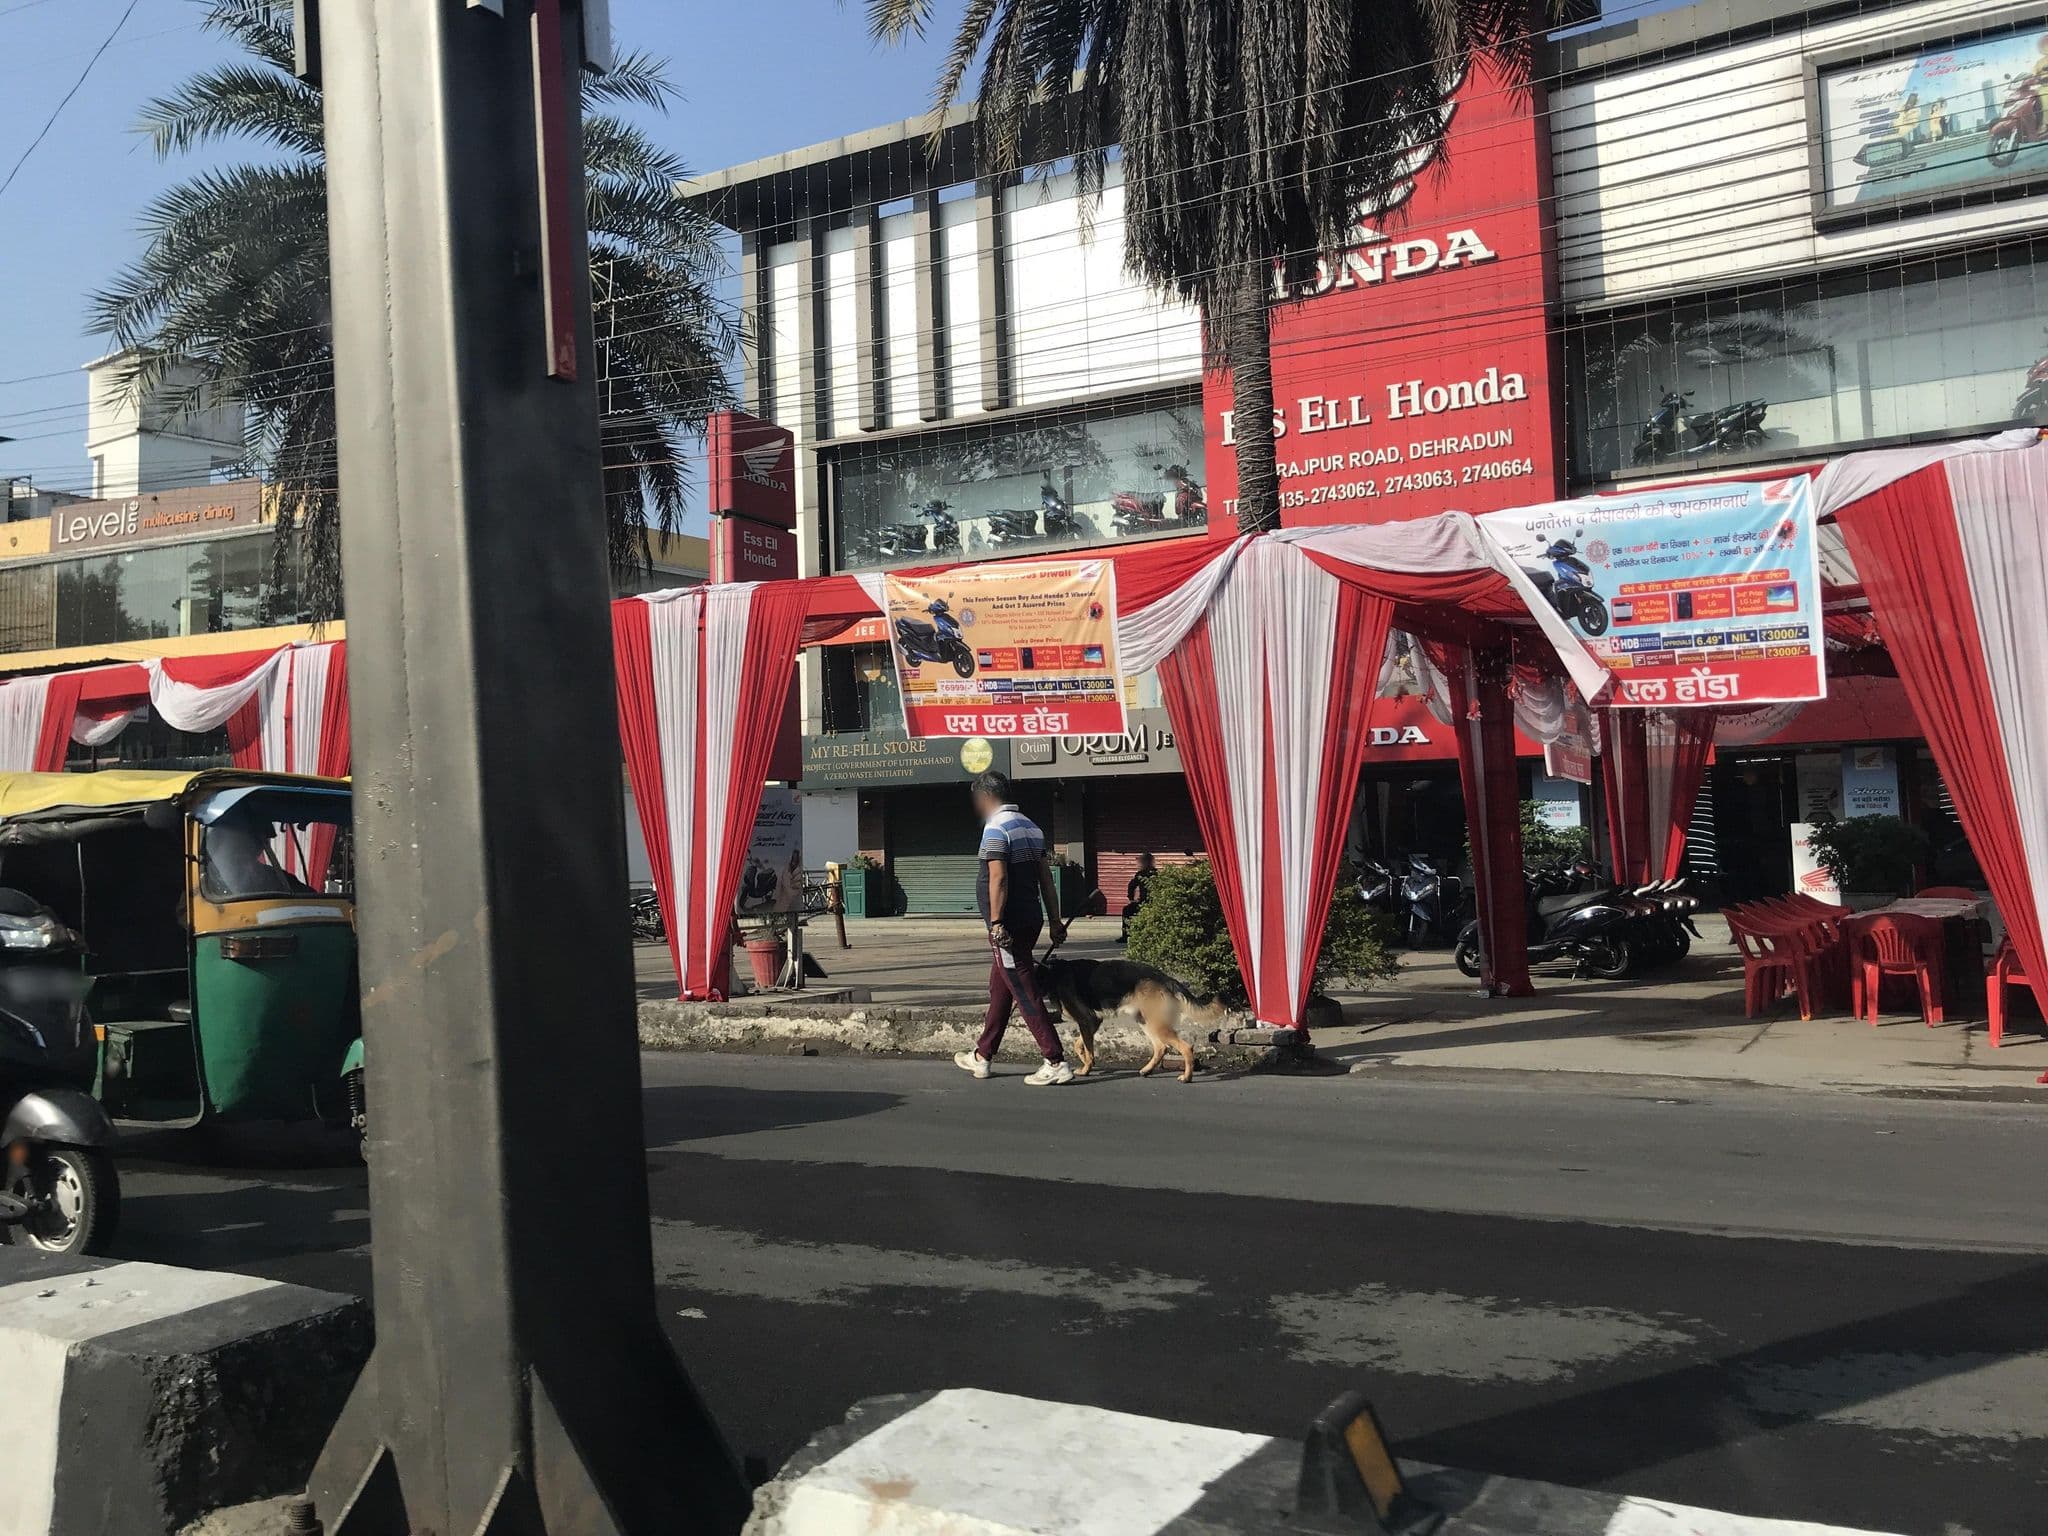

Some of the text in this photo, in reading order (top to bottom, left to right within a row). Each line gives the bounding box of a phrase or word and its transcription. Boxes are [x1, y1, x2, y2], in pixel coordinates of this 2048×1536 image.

[1387, 367, 1527, 420] Honda
[1275, 428, 1514, 478] RAJPUR ROAD, DEHRADUN
[742, 472, 788, 493] HONDA
[1278, 476, 1381, 508] 135-2743062,
[1384, 469, 1458, 494] 2743063,
[1461, 457, 1534, 484] 2740664
[57, 503, 127, 544] Level
[127, 500, 140, 534] one
[143, 504, 236, 529] multicuisine dining
[743, 530, 778, 551] Ess Ell
[743, 548, 777, 568] Honda
[1621, 638, 1640, 650] HDB
[984, 680, 998, 690] HDB
[1619, 678, 1669, 702] एल
[1672, 666, 1740, 701] होंडा
[944, 706, 1070, 733] एस एल होंडा
[810, 740, 928, 760] MY RE-FILL STORE
[1060, 724, 1147, 755] ORUM
[849, 770, 874, 779] WASTE
[873, 769, 915, 778] INITIATIVE
[887, 759, 898, 768] OF
